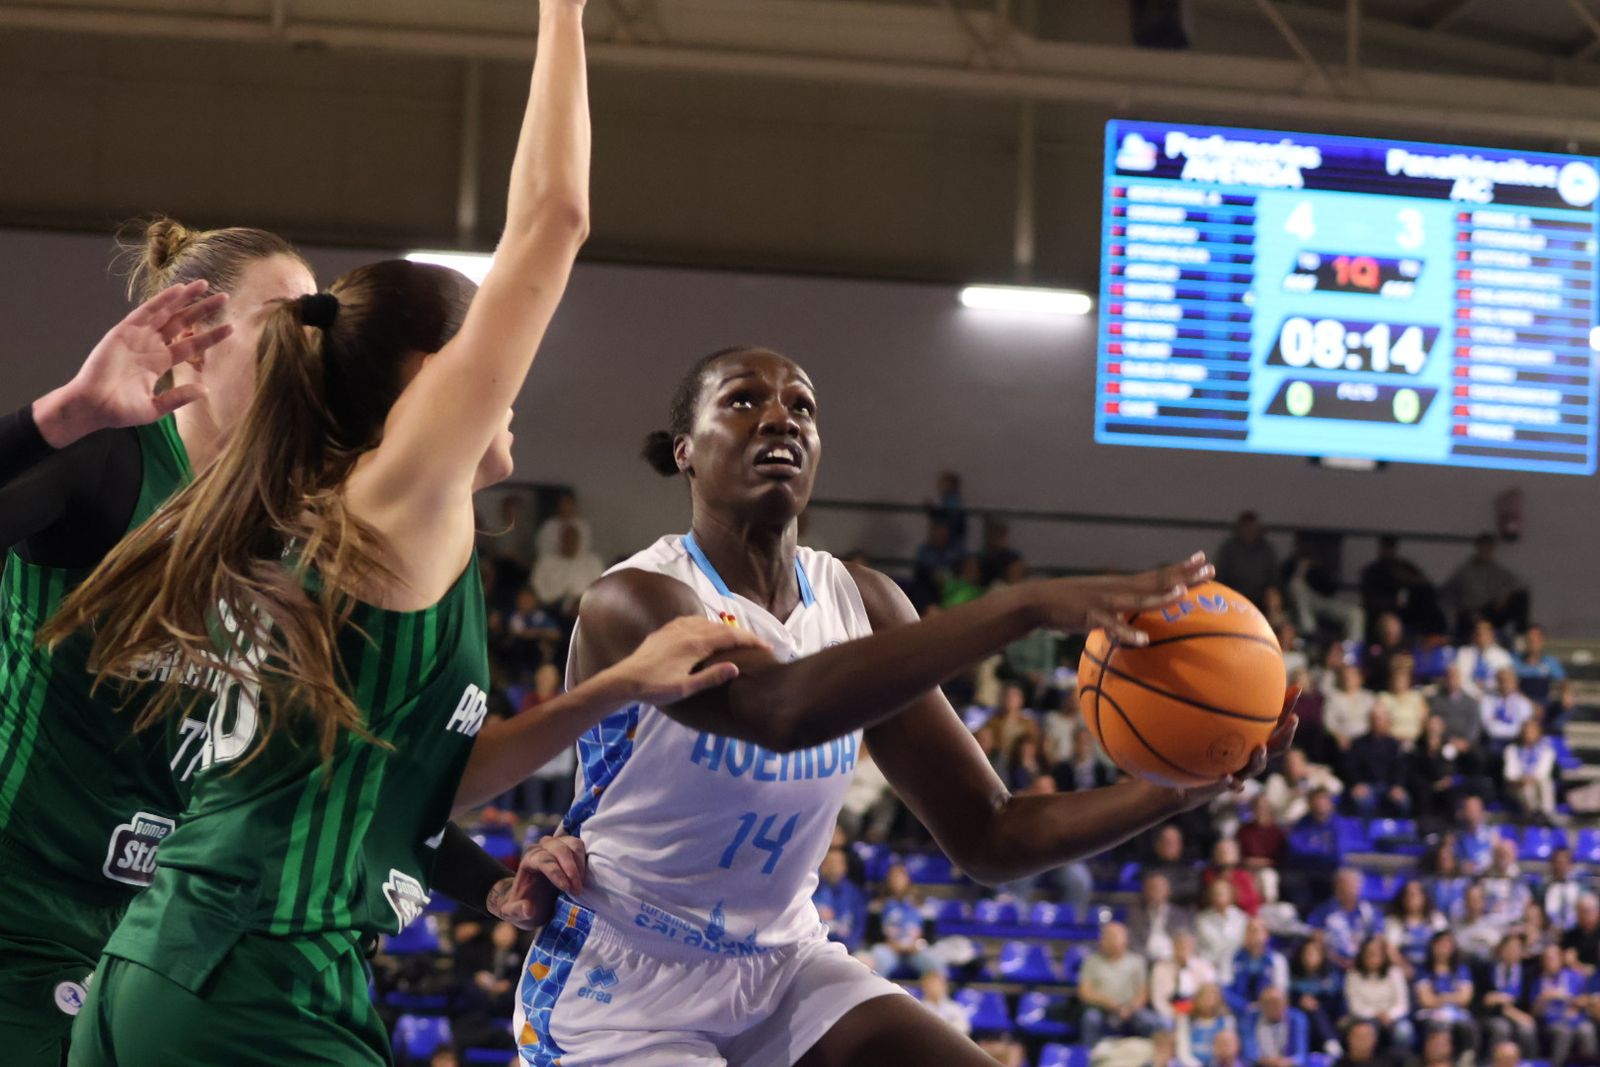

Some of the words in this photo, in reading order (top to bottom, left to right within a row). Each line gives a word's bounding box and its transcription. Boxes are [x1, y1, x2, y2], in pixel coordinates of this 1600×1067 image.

[1286, 202, 1314, 239] 4
[1397, 210, 1423, 250] 3
[1331, 256, 1379, 288] 1Q
[1281, 317, 1427, 374] 08:14
[1287, 382, 1312, 416] 0
[1394, 389, 1418, 423] 0
[718, 811, 801, 875] 14
